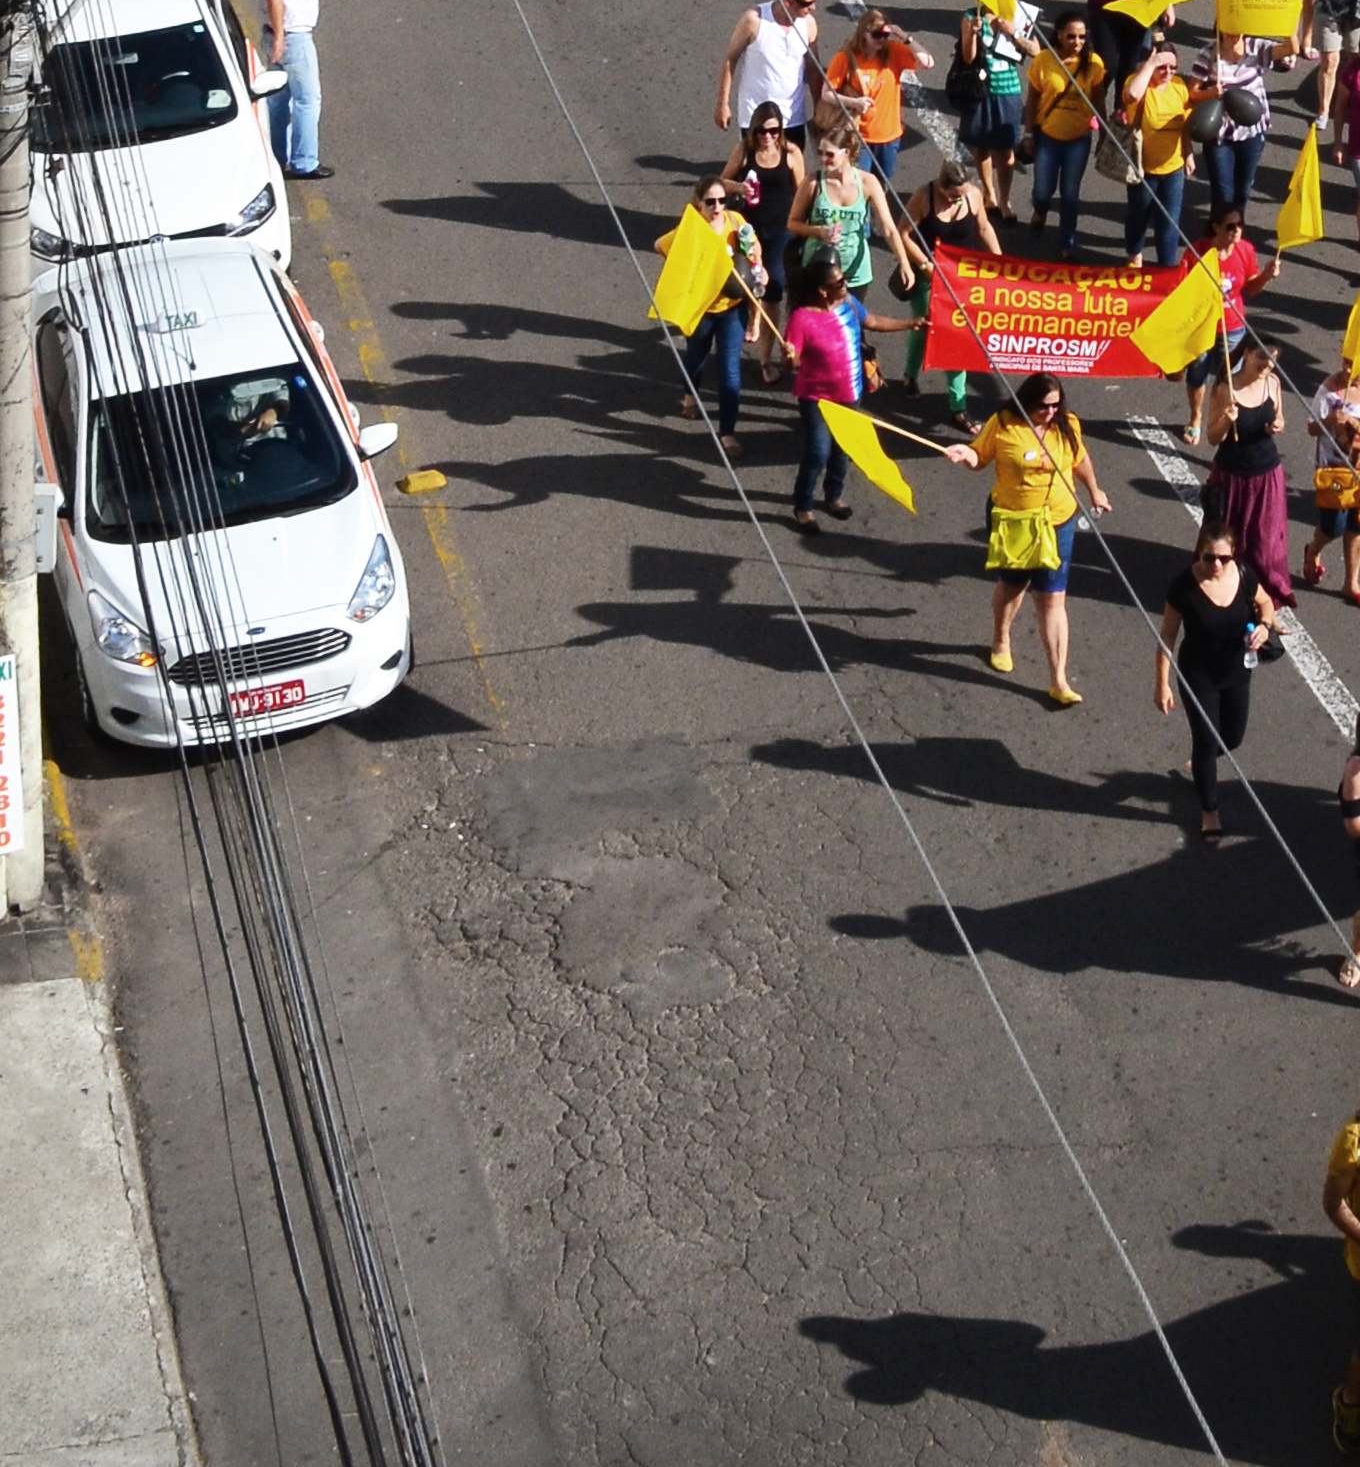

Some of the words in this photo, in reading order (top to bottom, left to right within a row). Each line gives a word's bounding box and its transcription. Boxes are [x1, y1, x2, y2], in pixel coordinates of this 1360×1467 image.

[815, 207, 864, 220] BEAUTY
[969, 286, 986, 305] a
[994, 287, 1072, 311] nossa
[1083, 289, 1129, 316] luta
[164, 310, 198, 332] TAXI
[951, 303, 969, 327] é
[975, 310, 1141, 338] permanente!
[987, 333, 1099, 357] SINPROSM
[991, 356, 1026, 364] INDICATO
